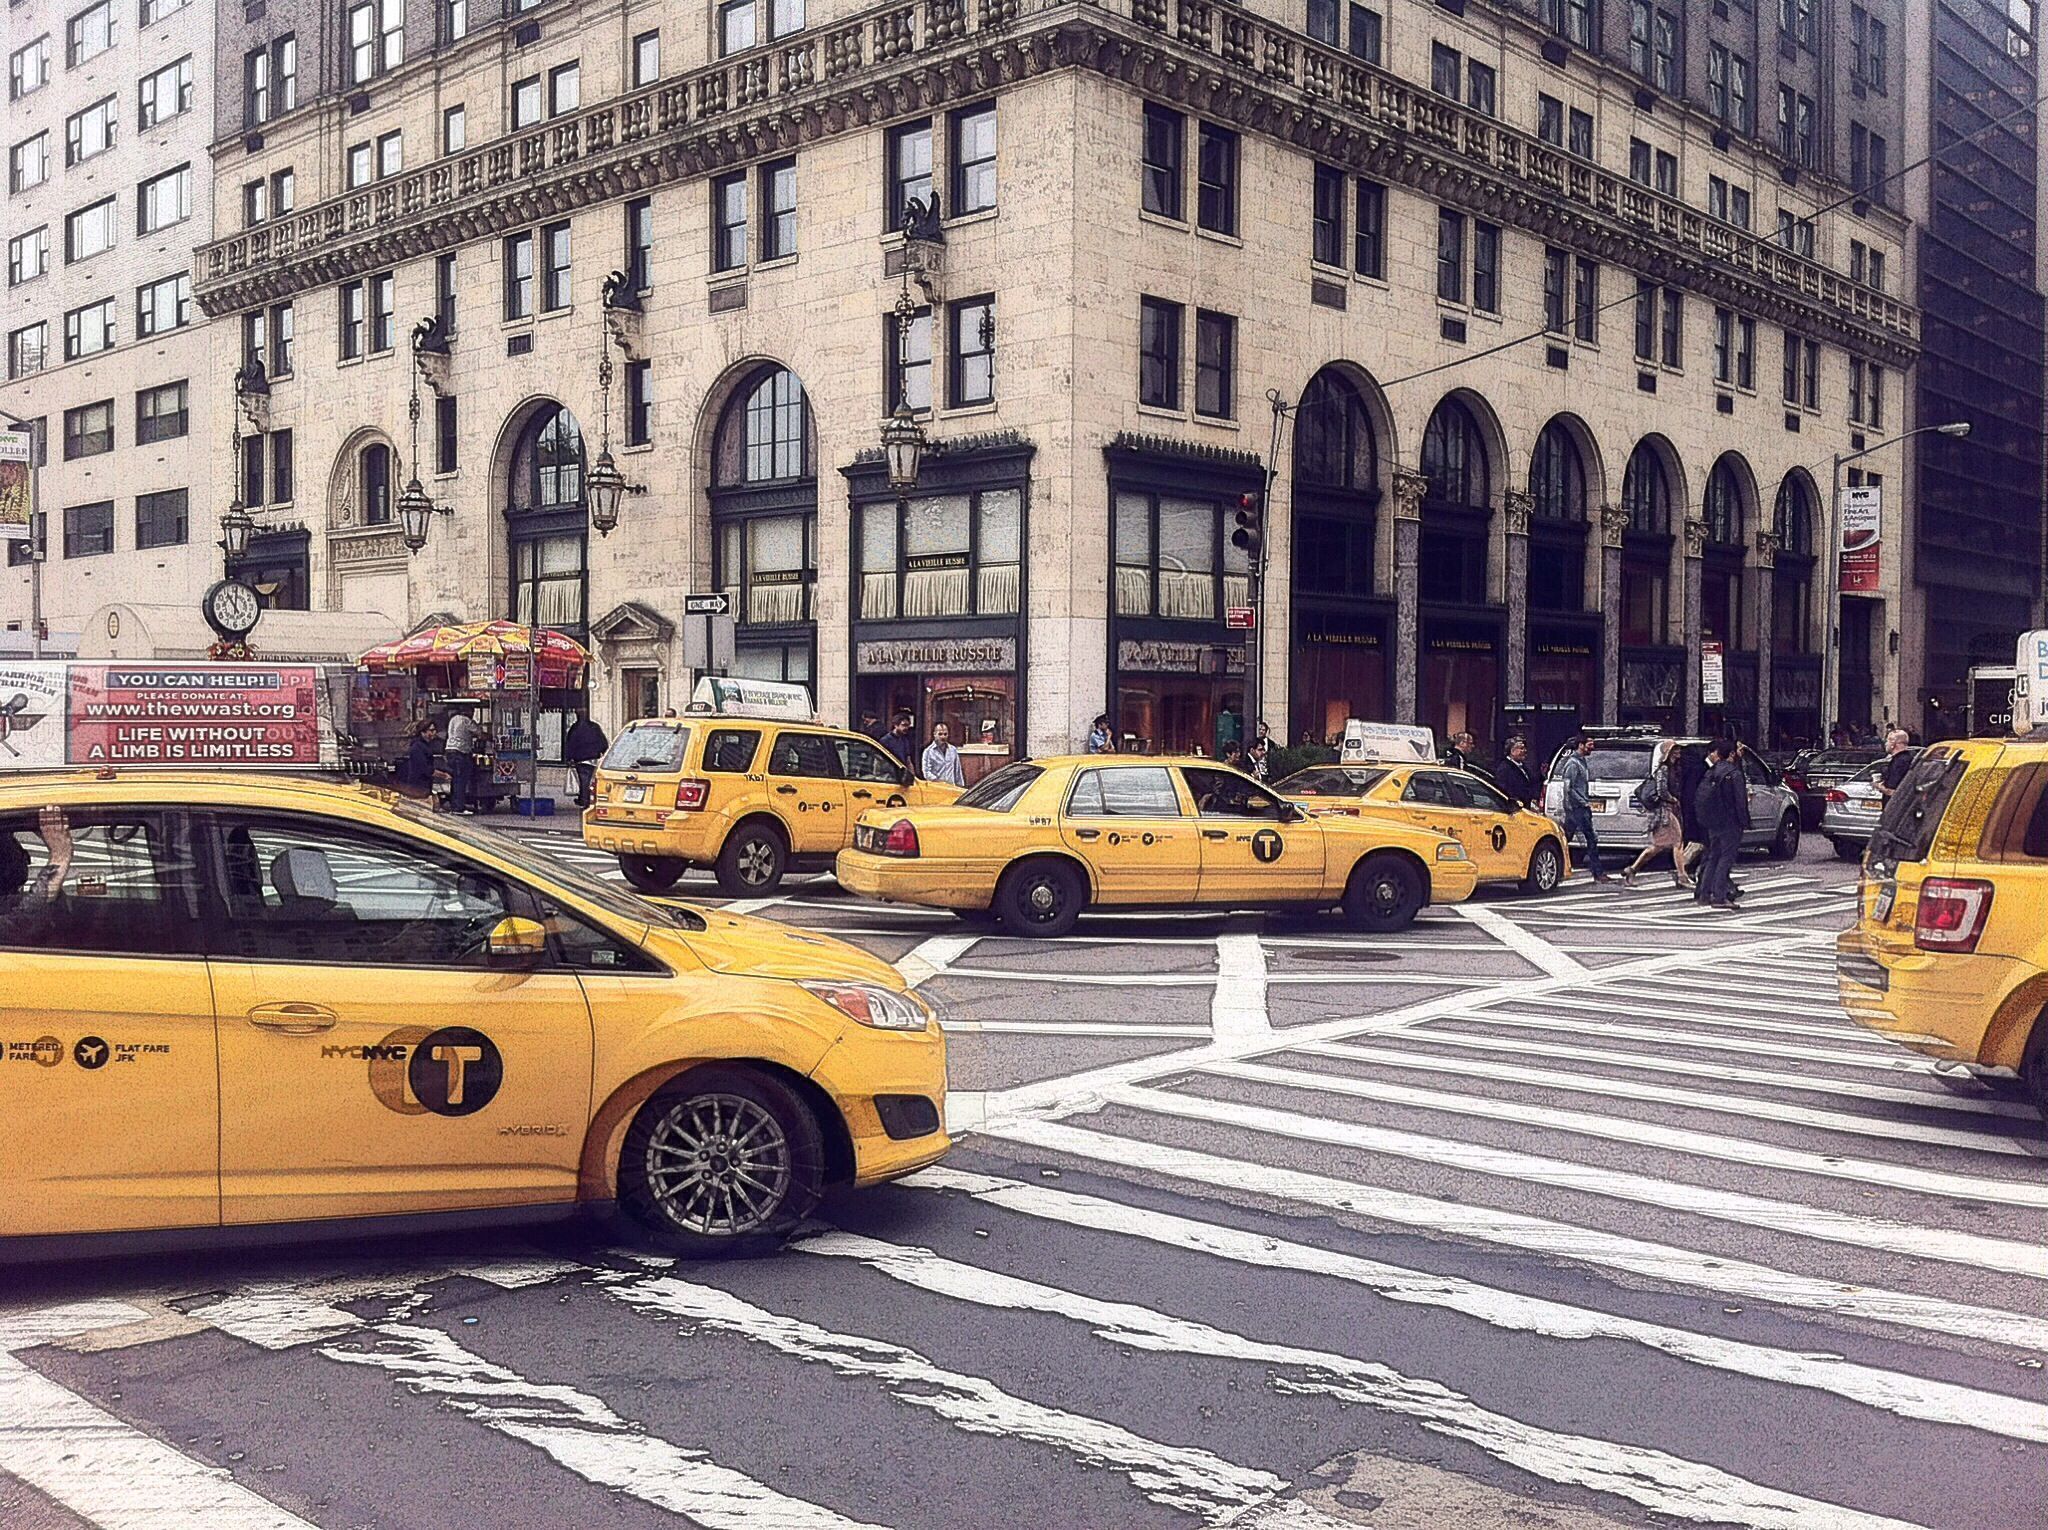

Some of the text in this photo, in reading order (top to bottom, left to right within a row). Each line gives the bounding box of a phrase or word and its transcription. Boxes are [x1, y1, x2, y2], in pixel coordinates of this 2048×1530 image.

[690, 600, 723, 609] ONE WAY
[868, 645, 1005, 665] A LA VIEILLE RUSSIE
[118, 674, 266, 687] YOU CAN HELP!
[136, 692, 178, 700] PLEASE
[181, 692, 226, 700] DONATE
[86, 702, 296, 719] www.thewwast.org
[118, 727, 266, 741] LIFE WITHOUT
[89, 744, 294, 758] A LIMB IS LIMITLESS
[9, 1042, 59, 1061] METERED FARE
[114, 1044, 170, 1053] FLAT FARE
[361, 1044, 408, 1061] NYC
[114, 1054, 136, 1063] JFK
